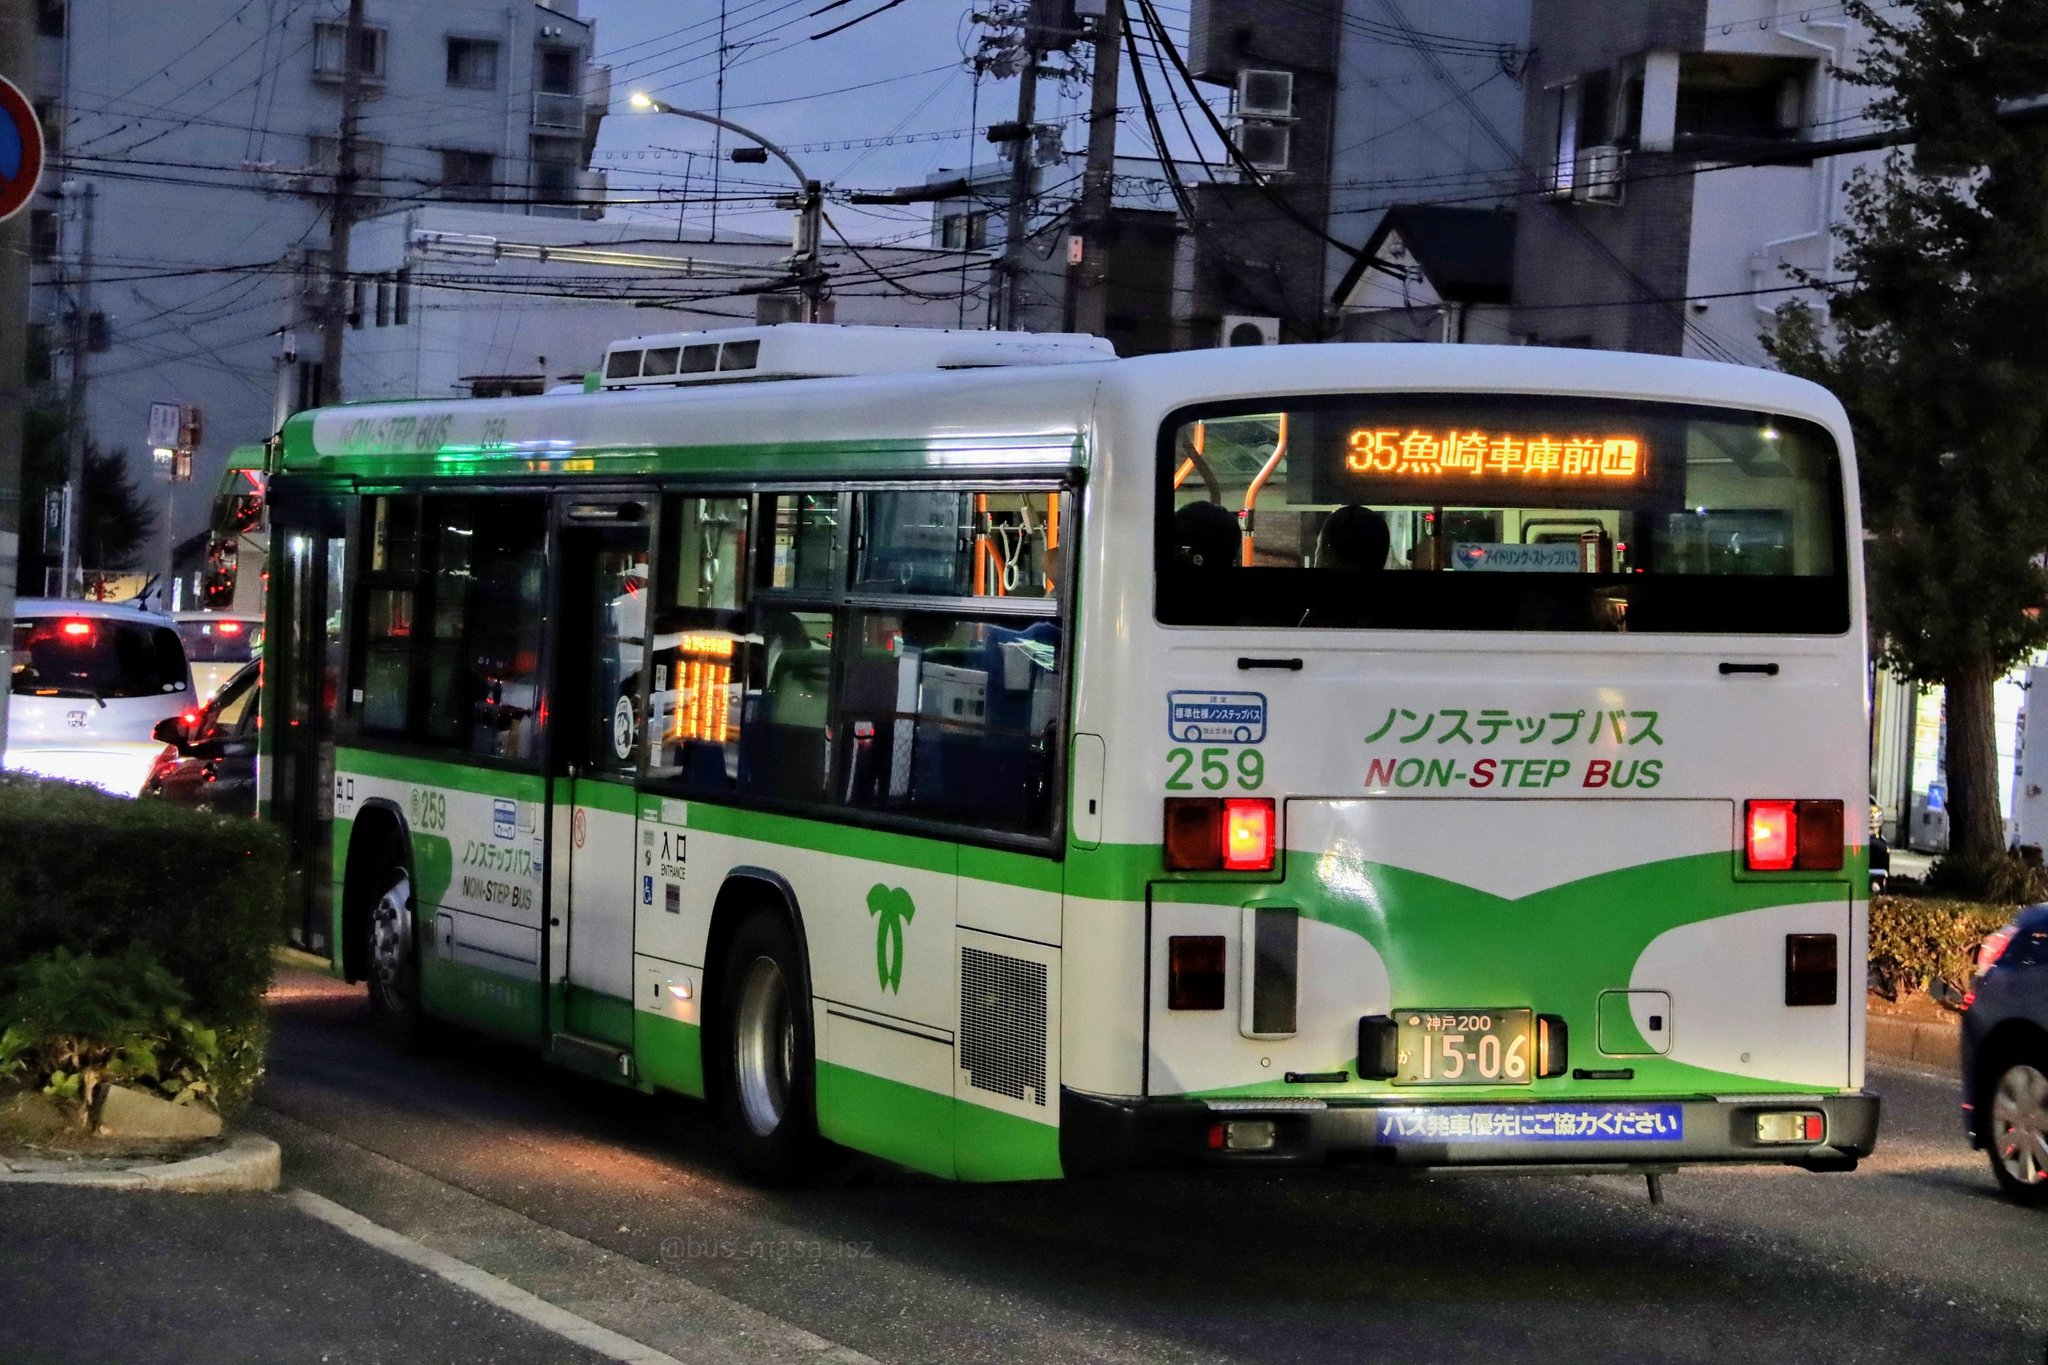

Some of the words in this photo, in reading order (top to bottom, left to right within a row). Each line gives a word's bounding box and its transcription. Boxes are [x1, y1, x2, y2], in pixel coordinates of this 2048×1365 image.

[339, 416, 416, 448] NON-STEP
[416, 413, 453, 449] BUS
[1175, 707, 1261, 720] 標準仕様ノンステップバス
[1364, 708, 1664, 746] ノンステップバス
[1165, 747, 1265, 791] 259
[1364, 758, 1571, 788] NON-STEP
[1582, 758, 1664, 788] BUS
[336, 775, 354, 801] 出口
[421, 790, 446, 831] 259
[463, 839, 532, 878] ノンステップバス
[661, 831, 687, 863] 入口
[661, 863, 686, 880] ENTRANCE
[463, 875, 510, 904] NON-STEP
[511, 886, 533, 910] BUS
[1423, 1034, 1527, 1079] 15-06
[1383, 1111, 1678, 1137] バス発車優先にご協力ください
